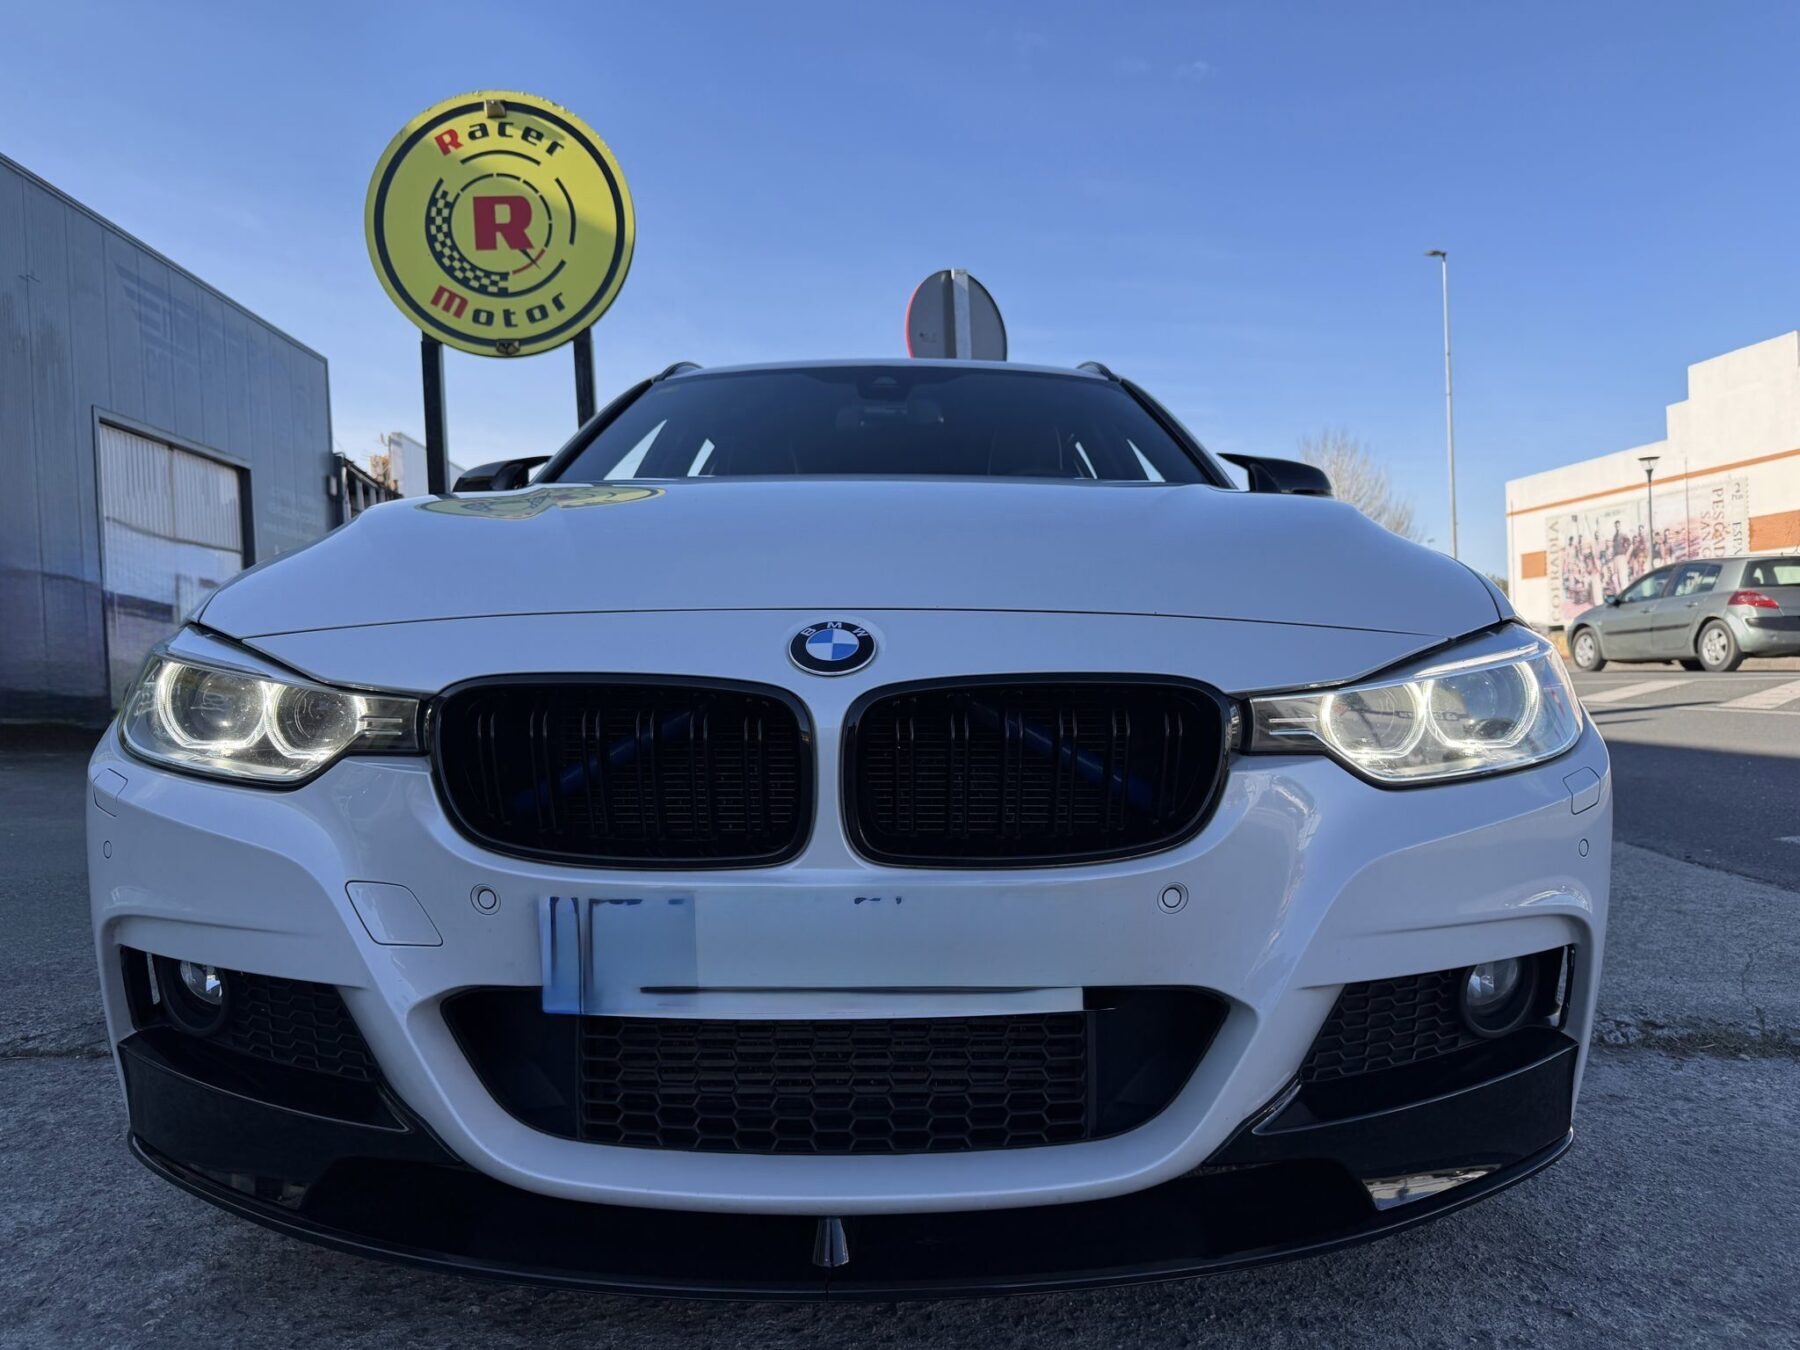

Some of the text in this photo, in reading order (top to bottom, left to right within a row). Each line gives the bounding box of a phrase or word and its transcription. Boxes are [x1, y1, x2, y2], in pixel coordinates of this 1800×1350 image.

[434, 121, 565, 156] Racer
[472, 195, 535, 251] R
[800, 622, 869, 637] BMW
